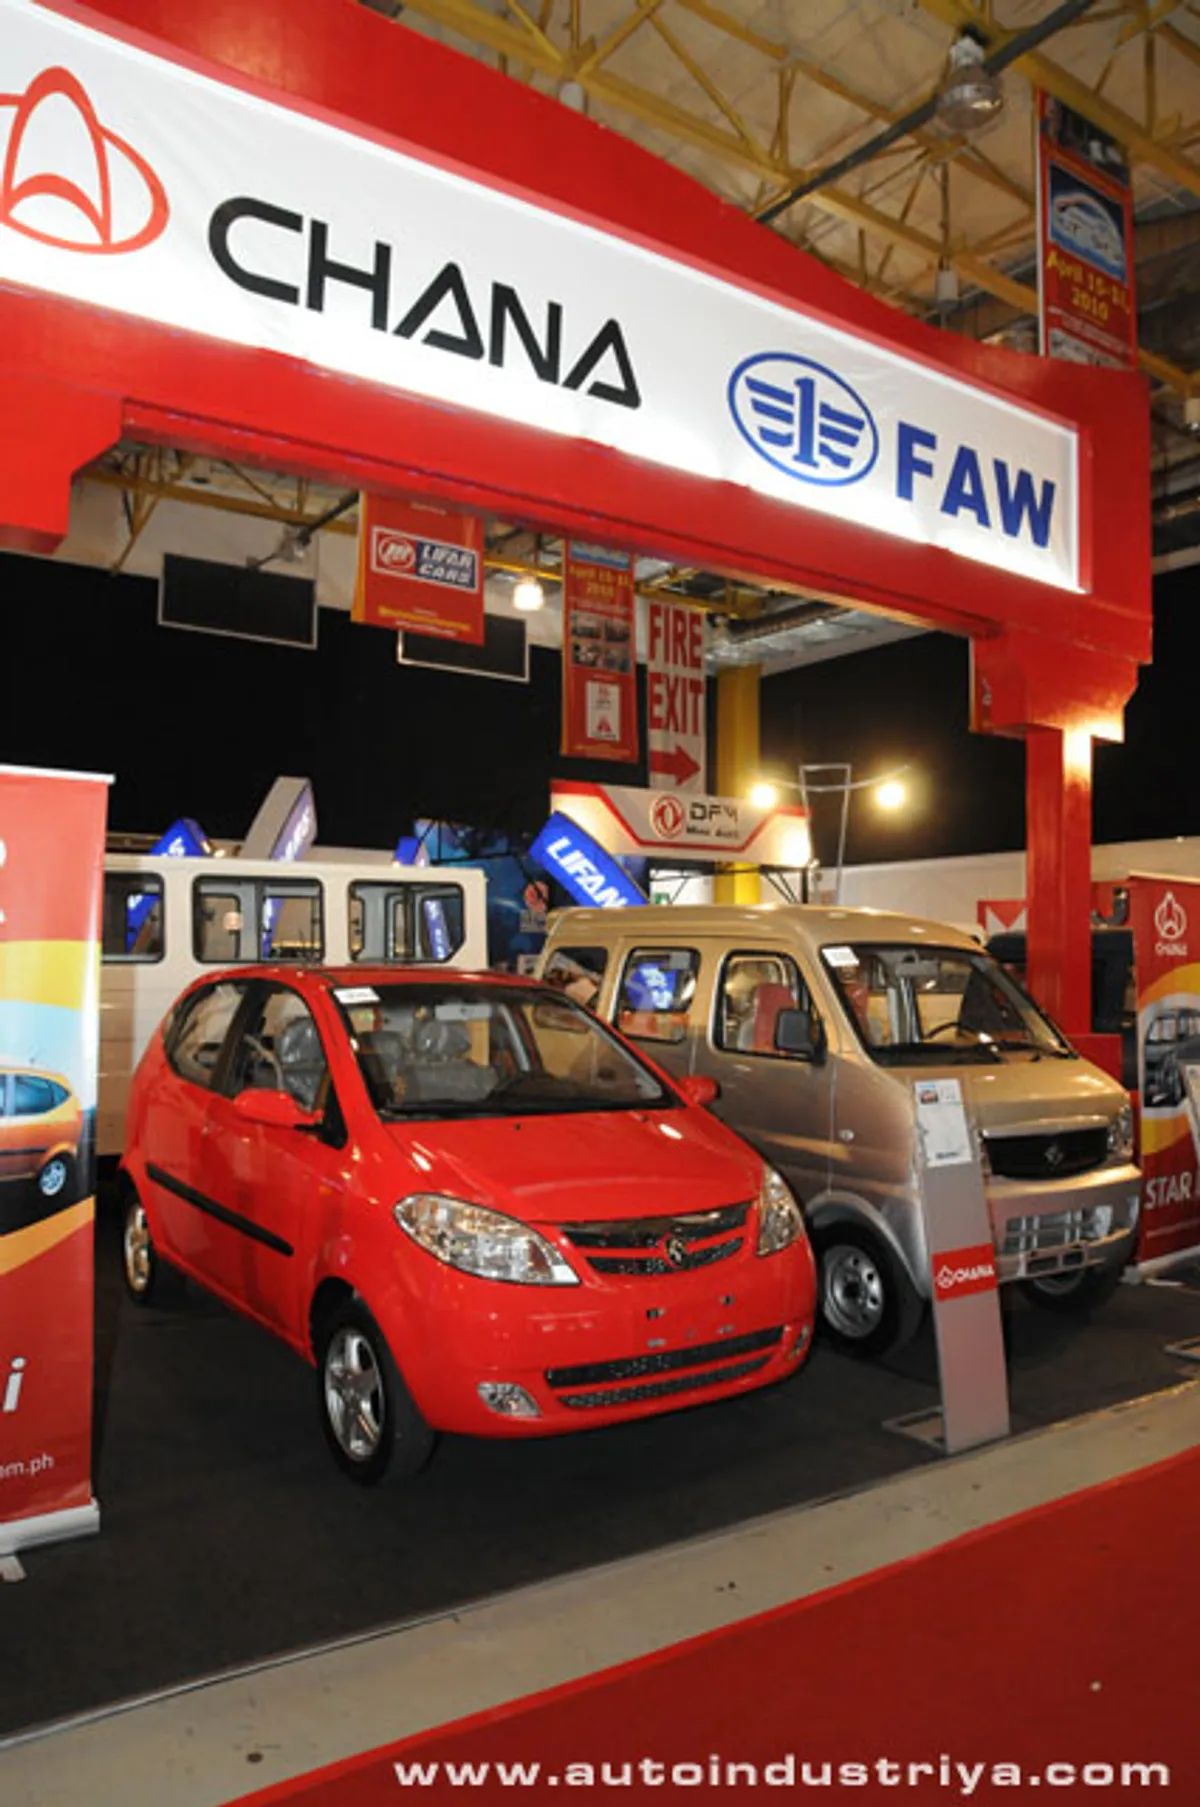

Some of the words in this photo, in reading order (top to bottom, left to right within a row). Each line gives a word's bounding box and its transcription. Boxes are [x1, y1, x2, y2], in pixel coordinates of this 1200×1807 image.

[208, 196, 641, 408] CHANA
[895, 421, 1056, 549] FAW
[650, 603, 703, 670] FIRE
[650, 671, 704, 737] EXIT
[546, 836, 628, 907] LIFAN
[1144, 1171, 1193, 1210] STAR
